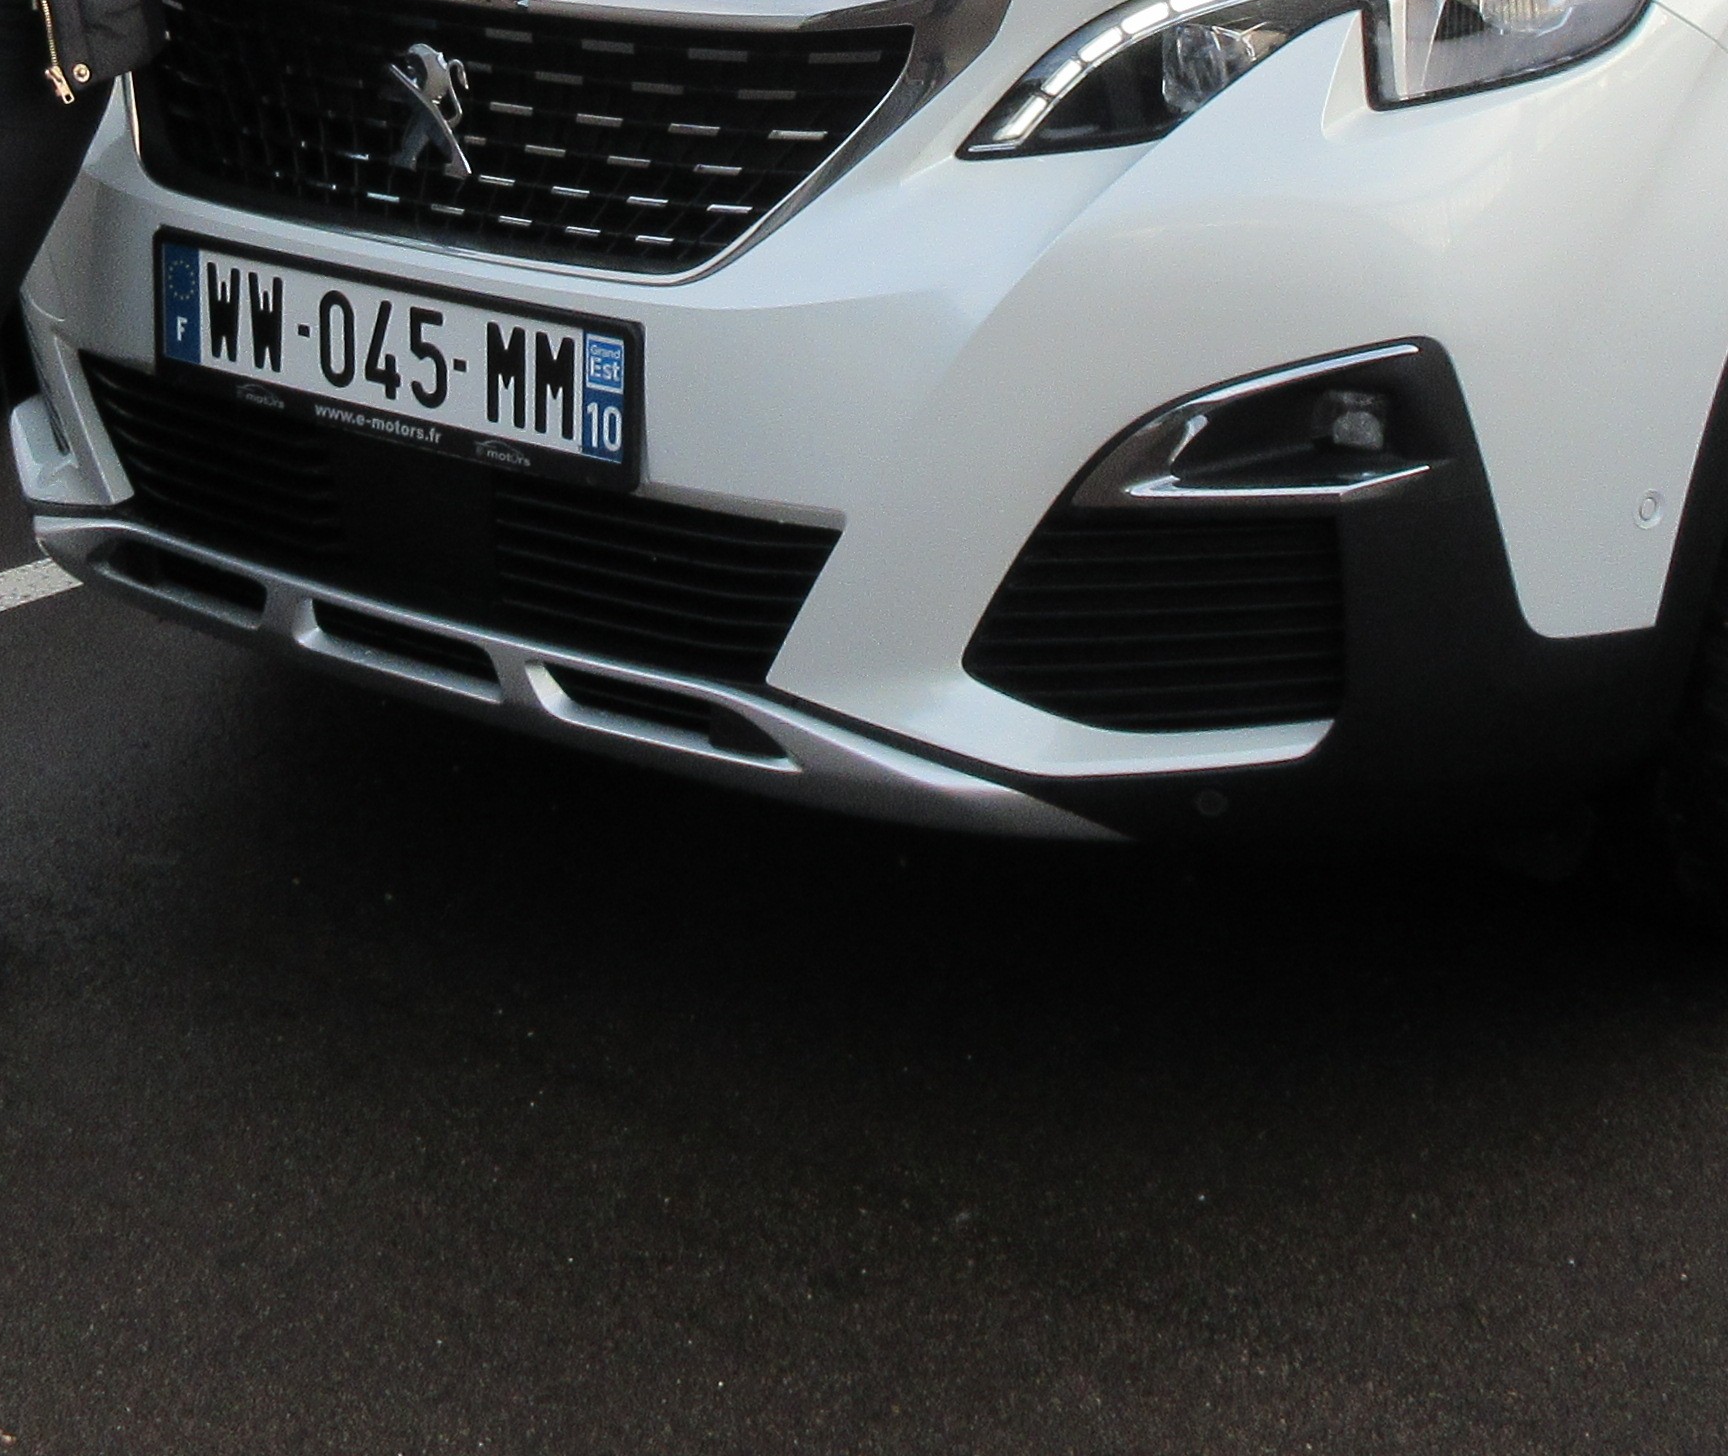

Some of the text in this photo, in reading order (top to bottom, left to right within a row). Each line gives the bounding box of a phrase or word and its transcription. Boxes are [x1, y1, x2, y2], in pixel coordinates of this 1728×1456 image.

[176, 318, 188, 341] F
[206, 261, 576, 441] WW-045-MM
[590, 344, 621, 360] Grand
[590, 357, 621, 381] Est
[314, 403, 442, 444] www.e-motors.fr
[587, 402, 622, 452] 10
